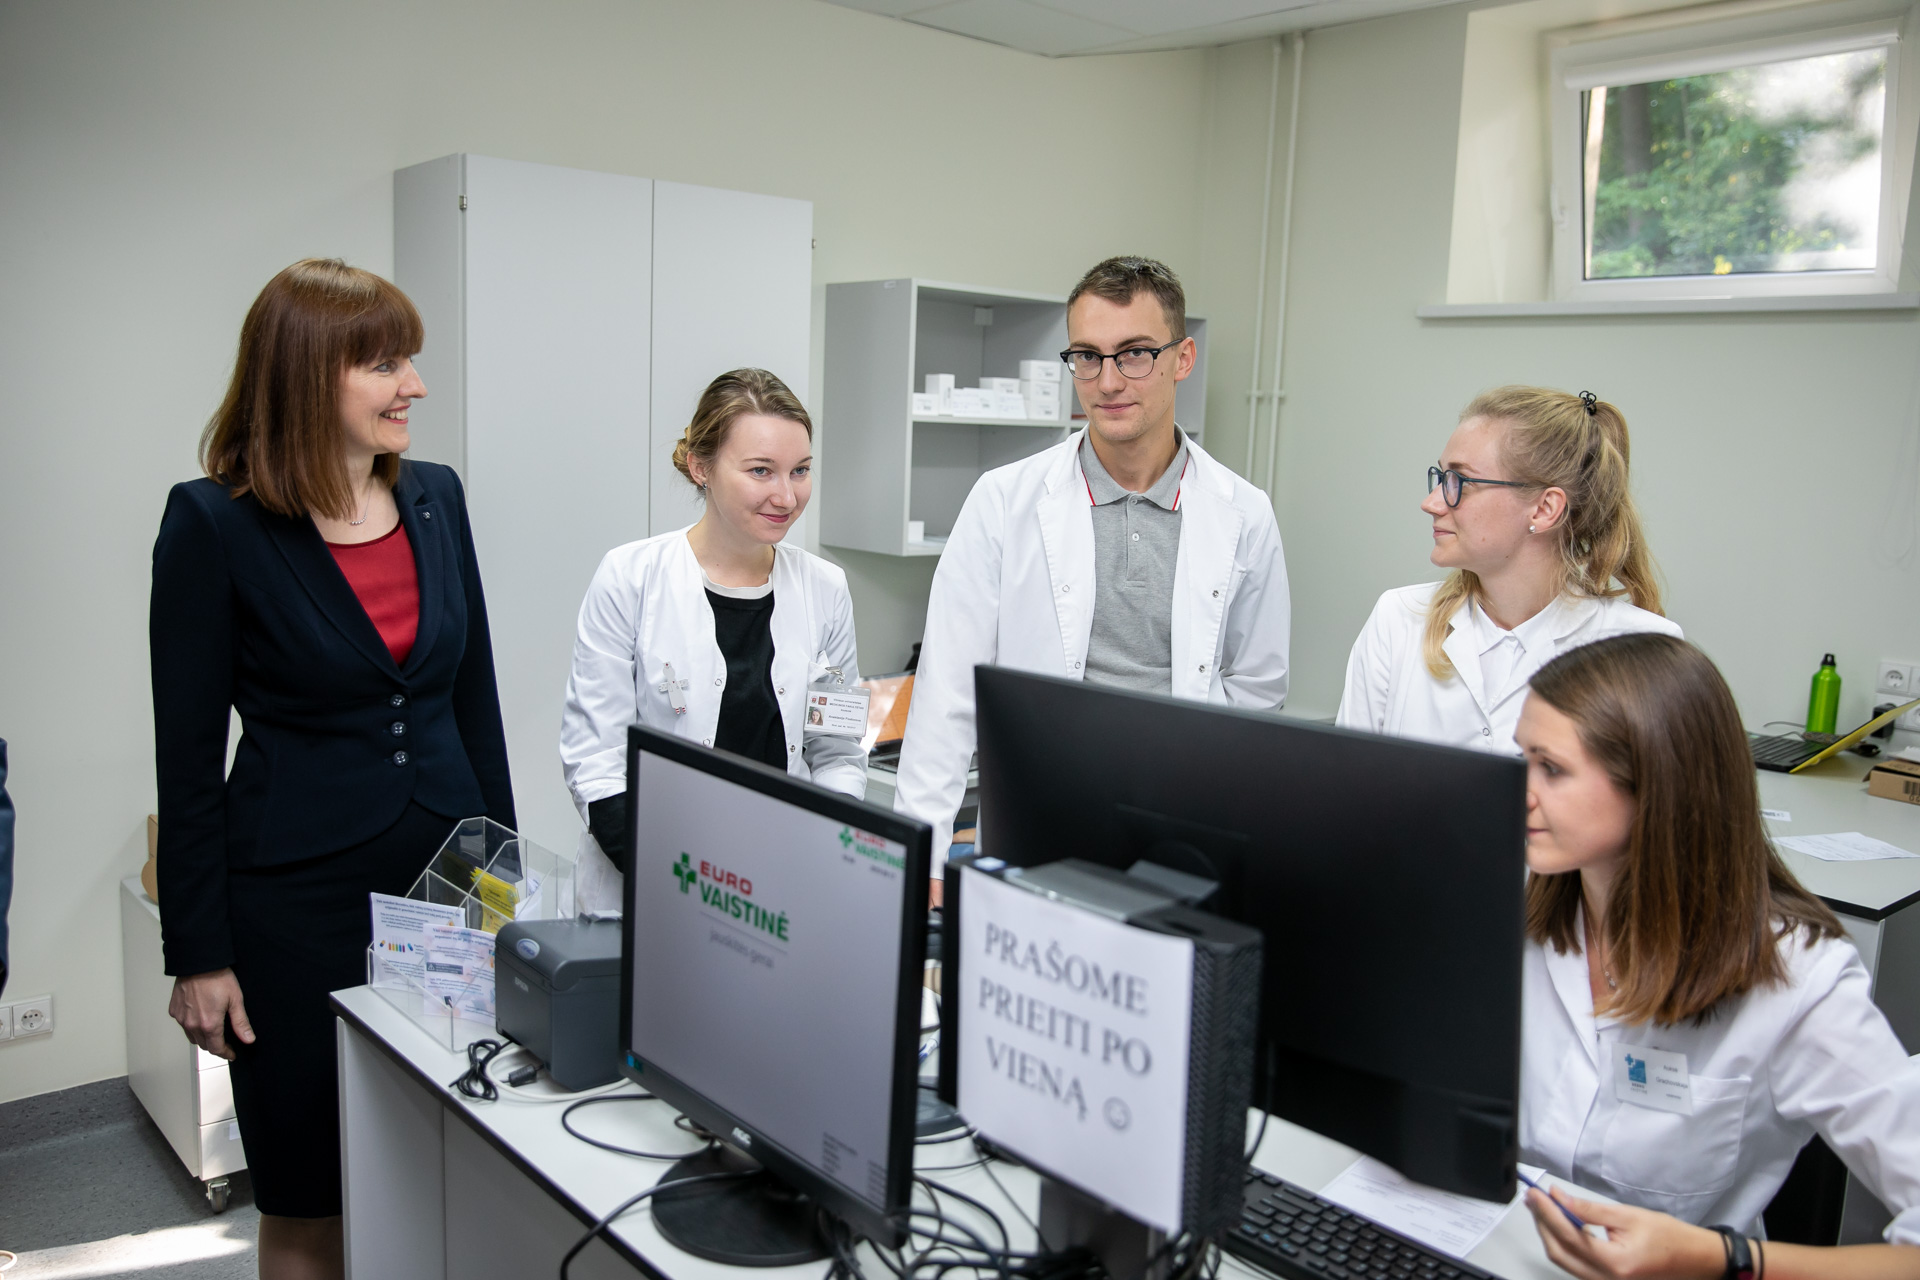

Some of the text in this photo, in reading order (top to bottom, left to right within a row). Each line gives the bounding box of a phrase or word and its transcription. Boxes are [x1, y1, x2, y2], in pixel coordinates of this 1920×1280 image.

[699, 860, 753, 896] EURO
[699, 880, 790, 942] VAISTINĖ
[984, 922, 1150, 1016] PRAŠOME
[978, 976, 1152, 1077] PRIEITI PO
[985, 1036, 1089, 1122] VIENĄ
